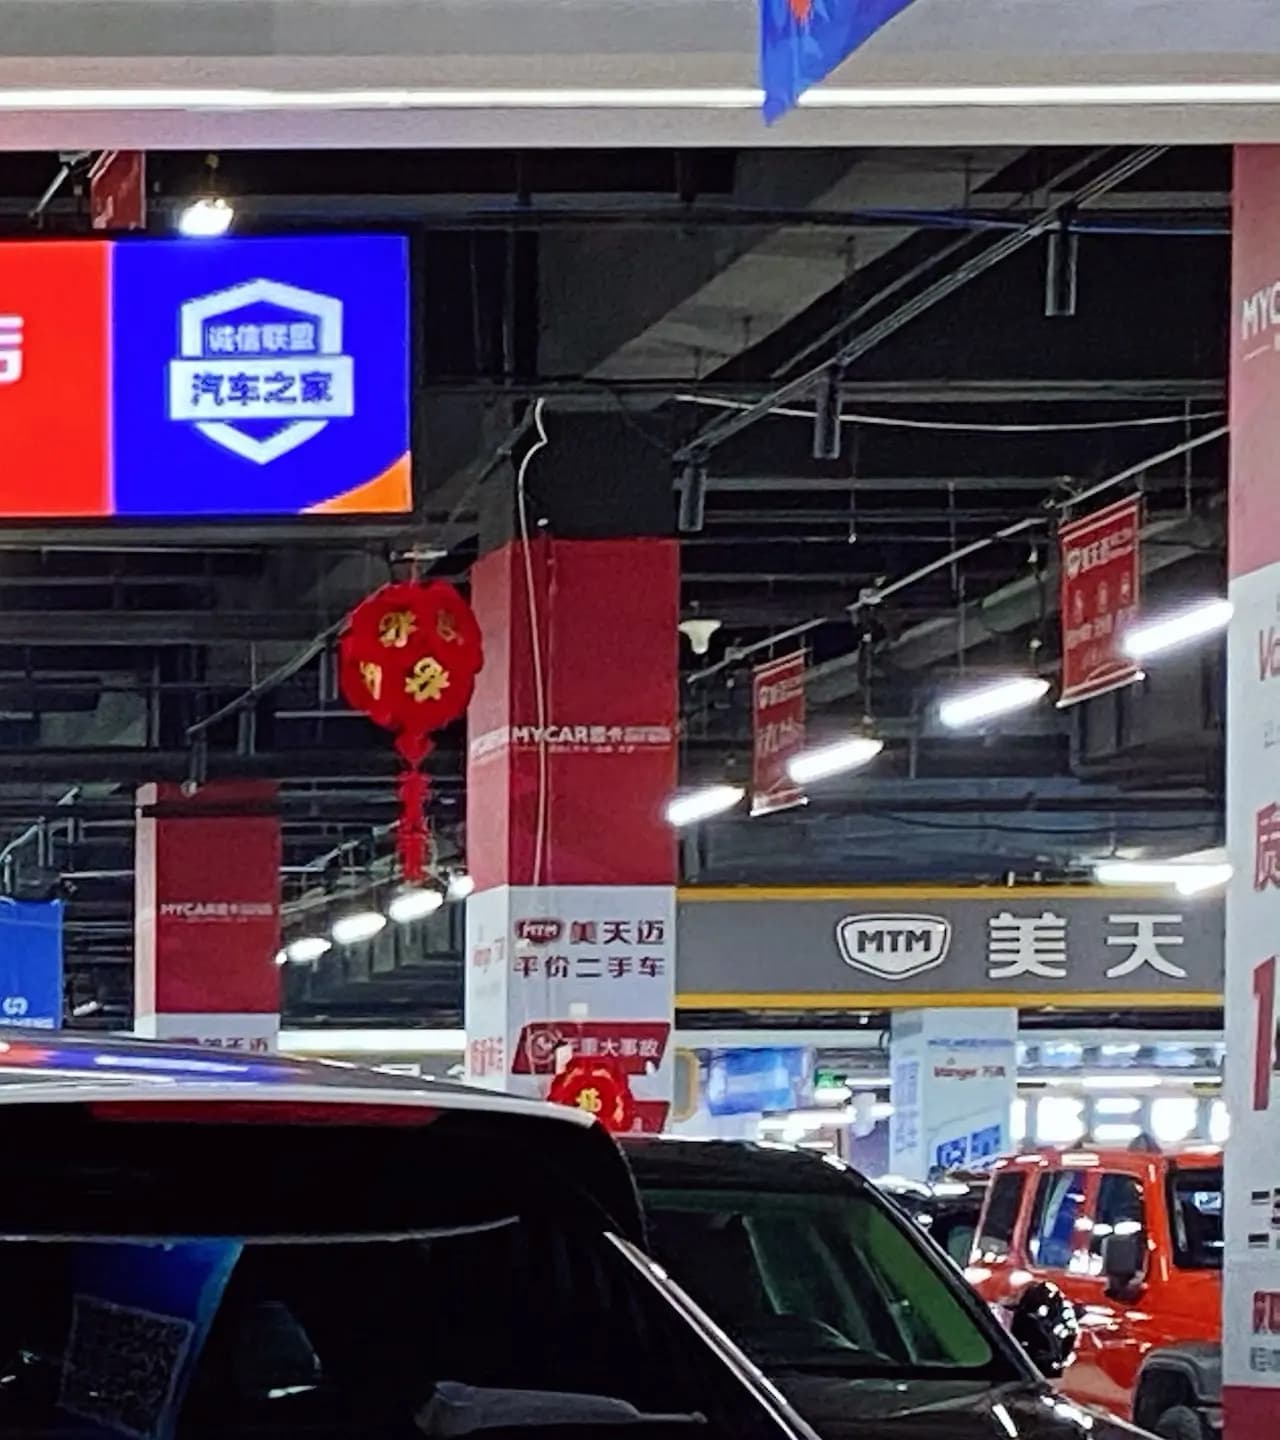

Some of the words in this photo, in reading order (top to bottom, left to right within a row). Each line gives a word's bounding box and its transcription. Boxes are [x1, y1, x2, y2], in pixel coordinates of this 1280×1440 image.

[191, 371, 334, 406] 汽车之家
[569, 920, 664, 945] 美天迈
[857, 930, 932, 953] MTM
[989, 912, 1188, 978] 美天
[513, 956, 665, 979] 平价二手车
